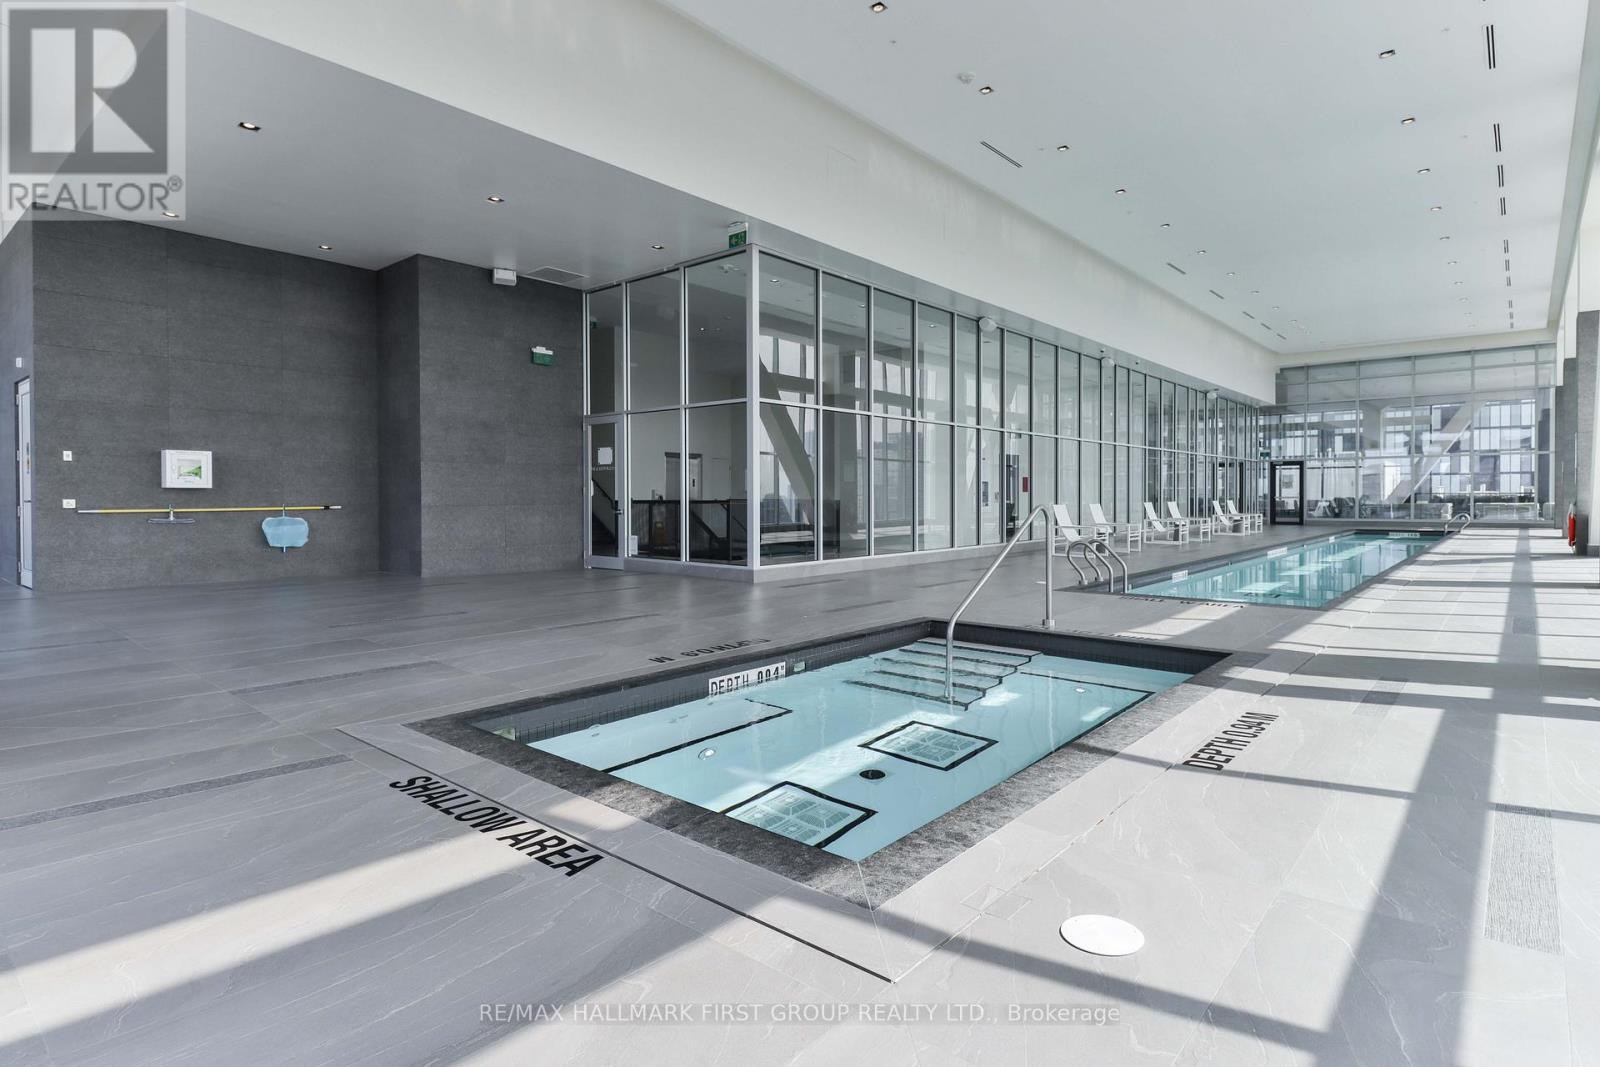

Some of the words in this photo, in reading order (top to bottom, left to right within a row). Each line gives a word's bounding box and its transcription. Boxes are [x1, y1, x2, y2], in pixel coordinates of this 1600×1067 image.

[710, 674, 749, 696] DEPTH
[1182, 736, 1251, 770] DEPTH
[1241, 711, 1279, 721] M
[389, 775, 527, 833] SHALLOW
[495, 828, 604, 877] AREA
